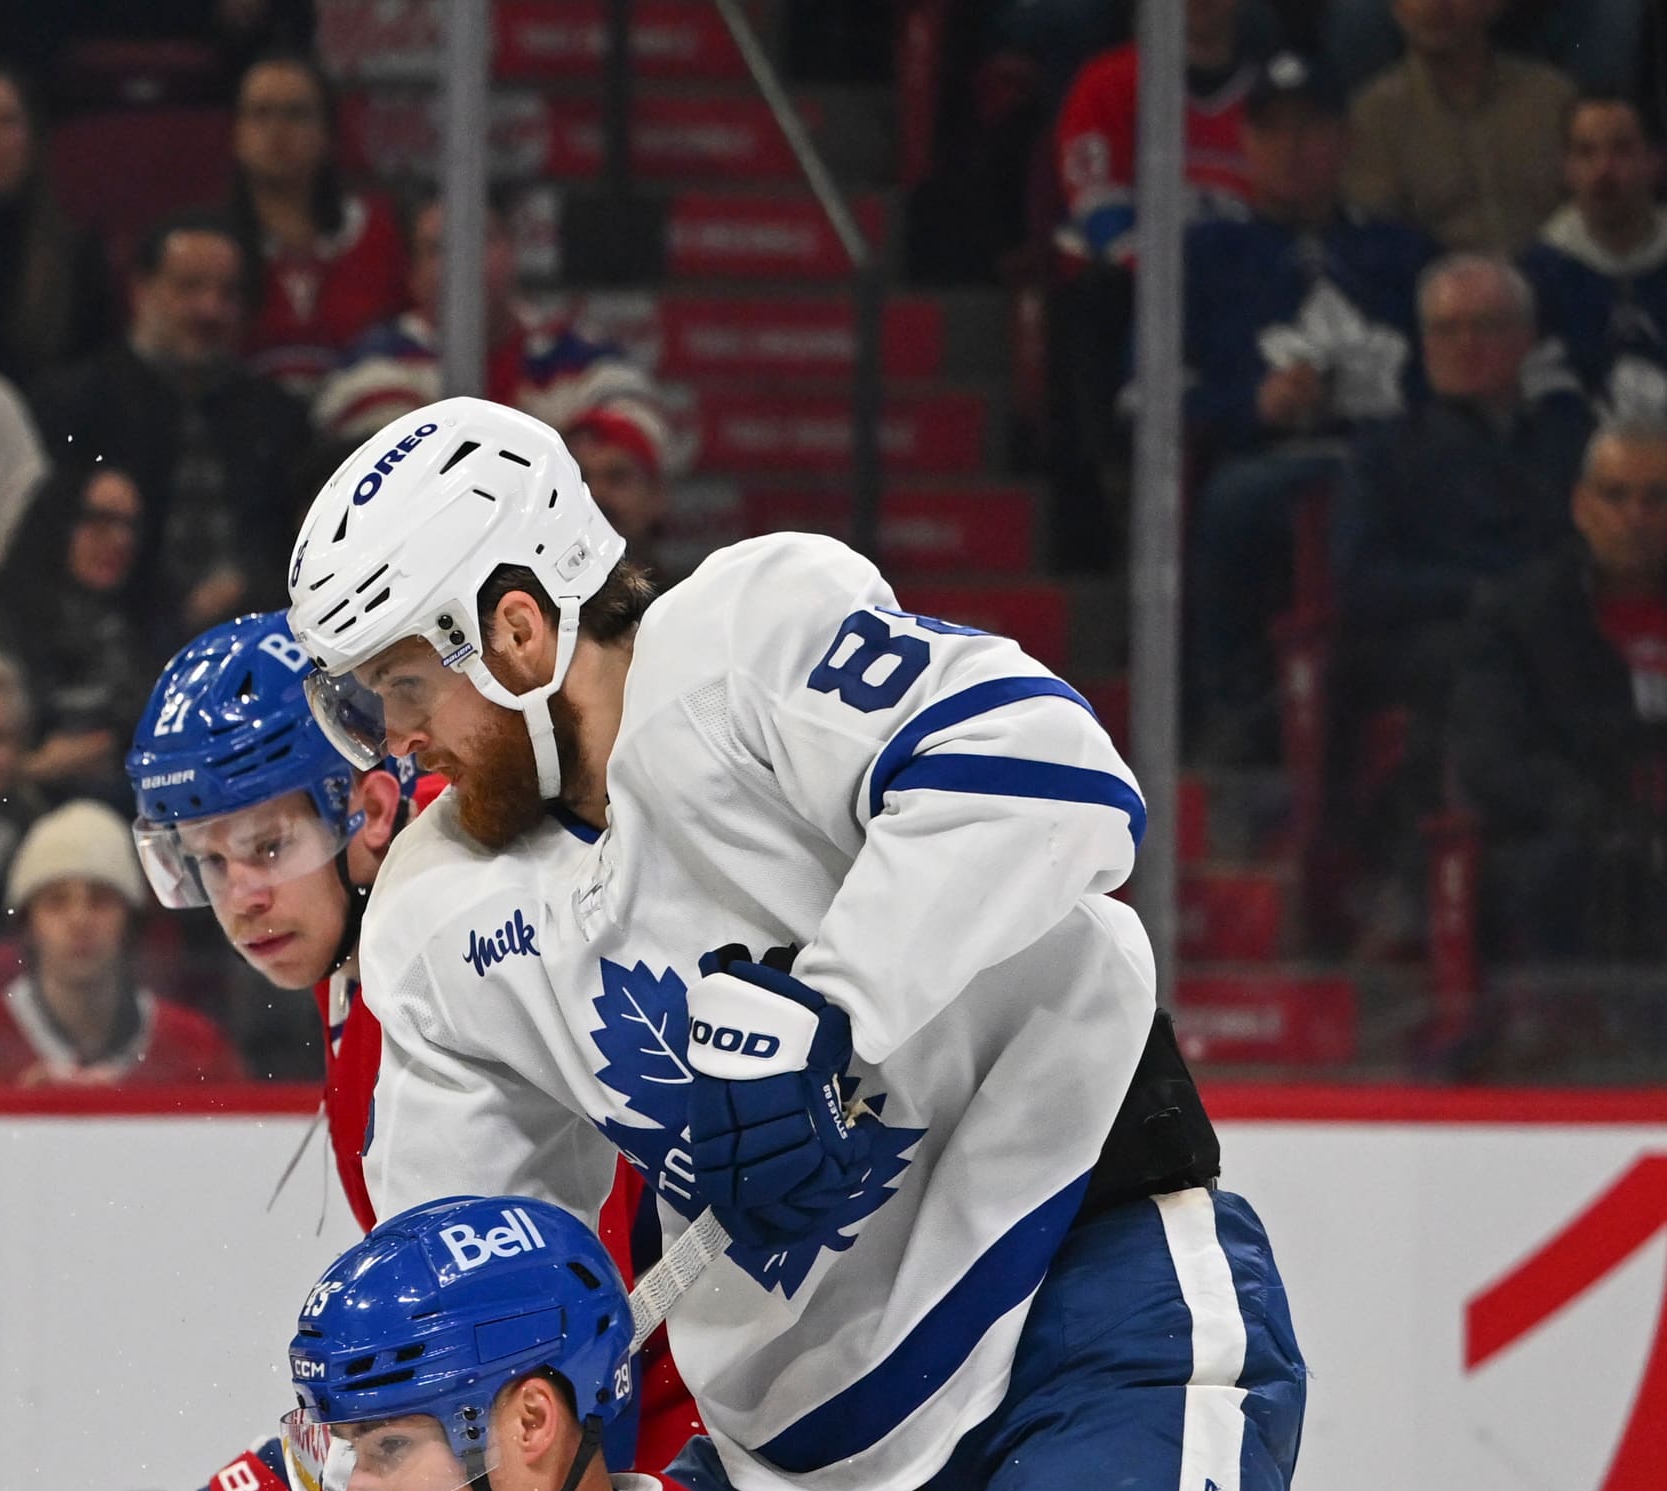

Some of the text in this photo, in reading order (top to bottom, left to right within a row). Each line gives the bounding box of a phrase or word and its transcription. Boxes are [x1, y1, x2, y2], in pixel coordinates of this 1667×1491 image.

[352, 422, 438, 507] OREO
[442, 643, 472, 668] BAUER
[153, 693, 194, 737] 21
[141, 768, 196, 790] BAUER
[689, 1016, 781, 1059] OOD
[438, 1207, 547, 1273] Bell
[294, 1358, 326, 1379] CCM
[613, 1362, 632, 1401] 29
